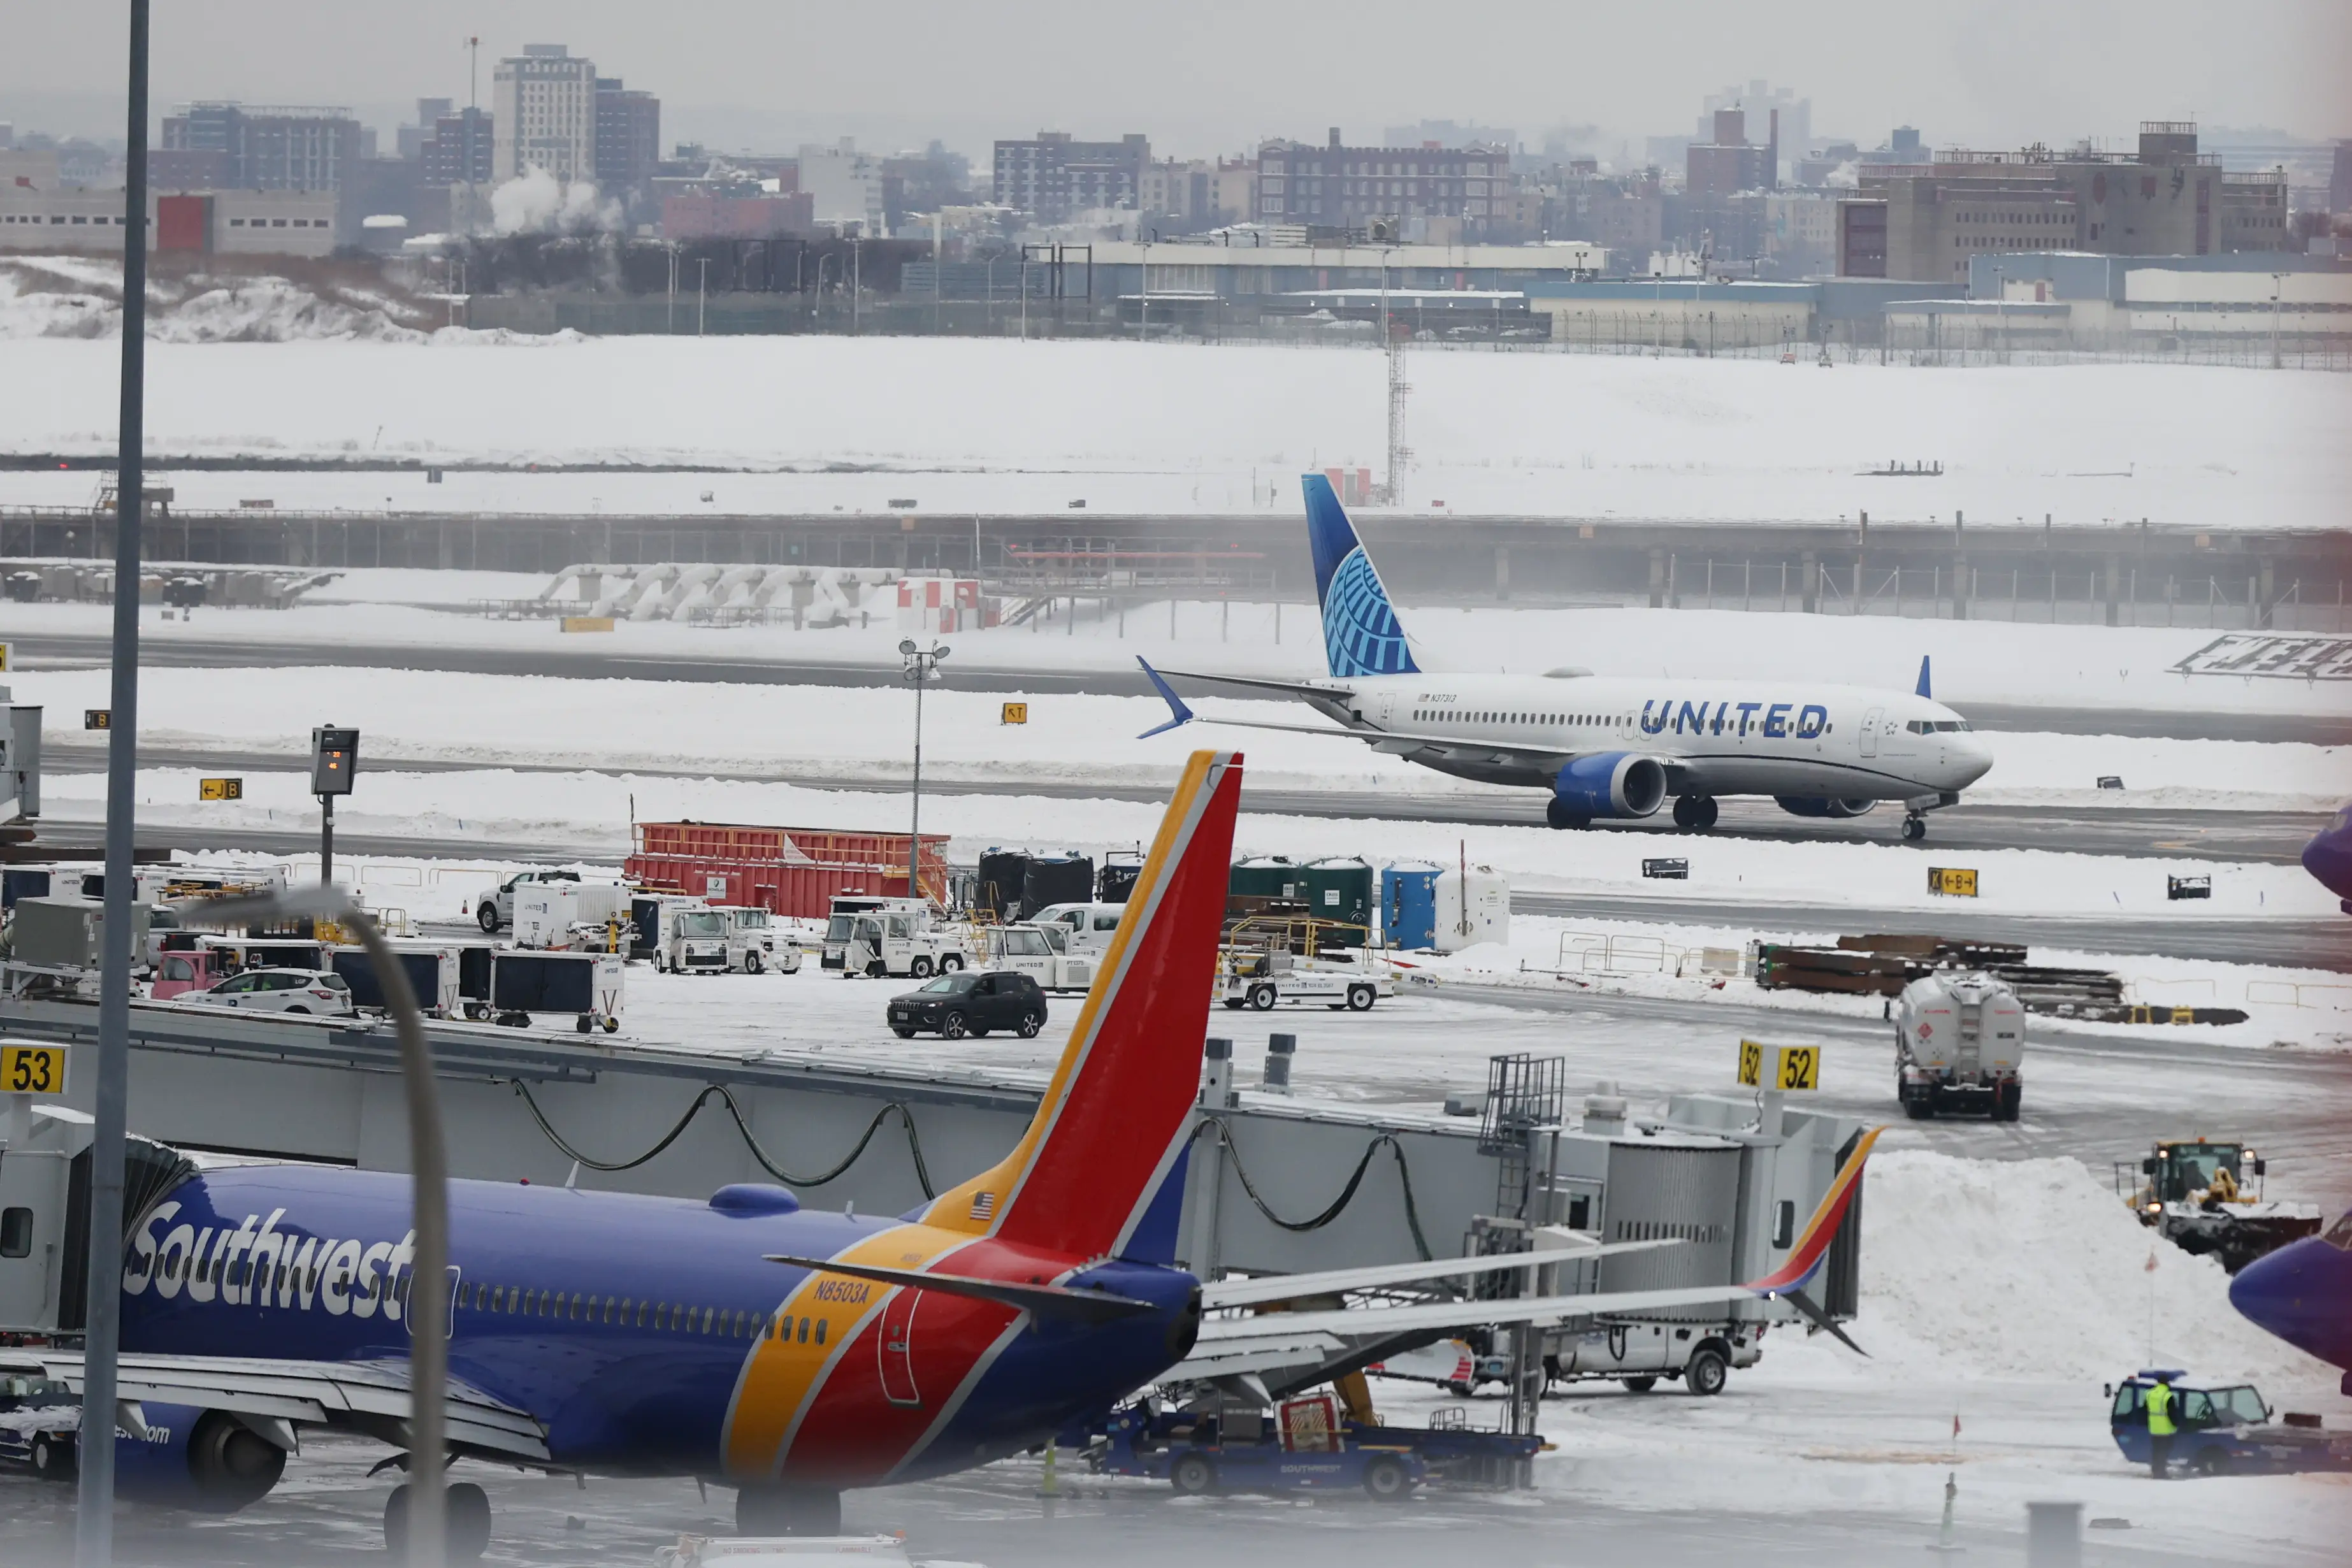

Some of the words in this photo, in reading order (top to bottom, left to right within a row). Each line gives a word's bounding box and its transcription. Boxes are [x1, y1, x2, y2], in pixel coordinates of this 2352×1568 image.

[1431, 694, 1457, 702] N37313
[99, 714, 106, 726] B
[1017, 707, 1023, 719] T
[1641, 700, 1827, 739] UNITED
[217, 784, 224, 796] J
[229, 782, 238, 796] B
[1956, 875, 1963, 889] B
[13, 1050, 50, 1091] 53
[1745, 1045, 1759, 1085] 52
[1786, 1050, 1810, 1089] 52
[123, 1200, 417, 1321] Southwest
[813, 1281, 871, 1304] N8503A
[1280, 1465, 1341, 1474] SOUTHWEST
